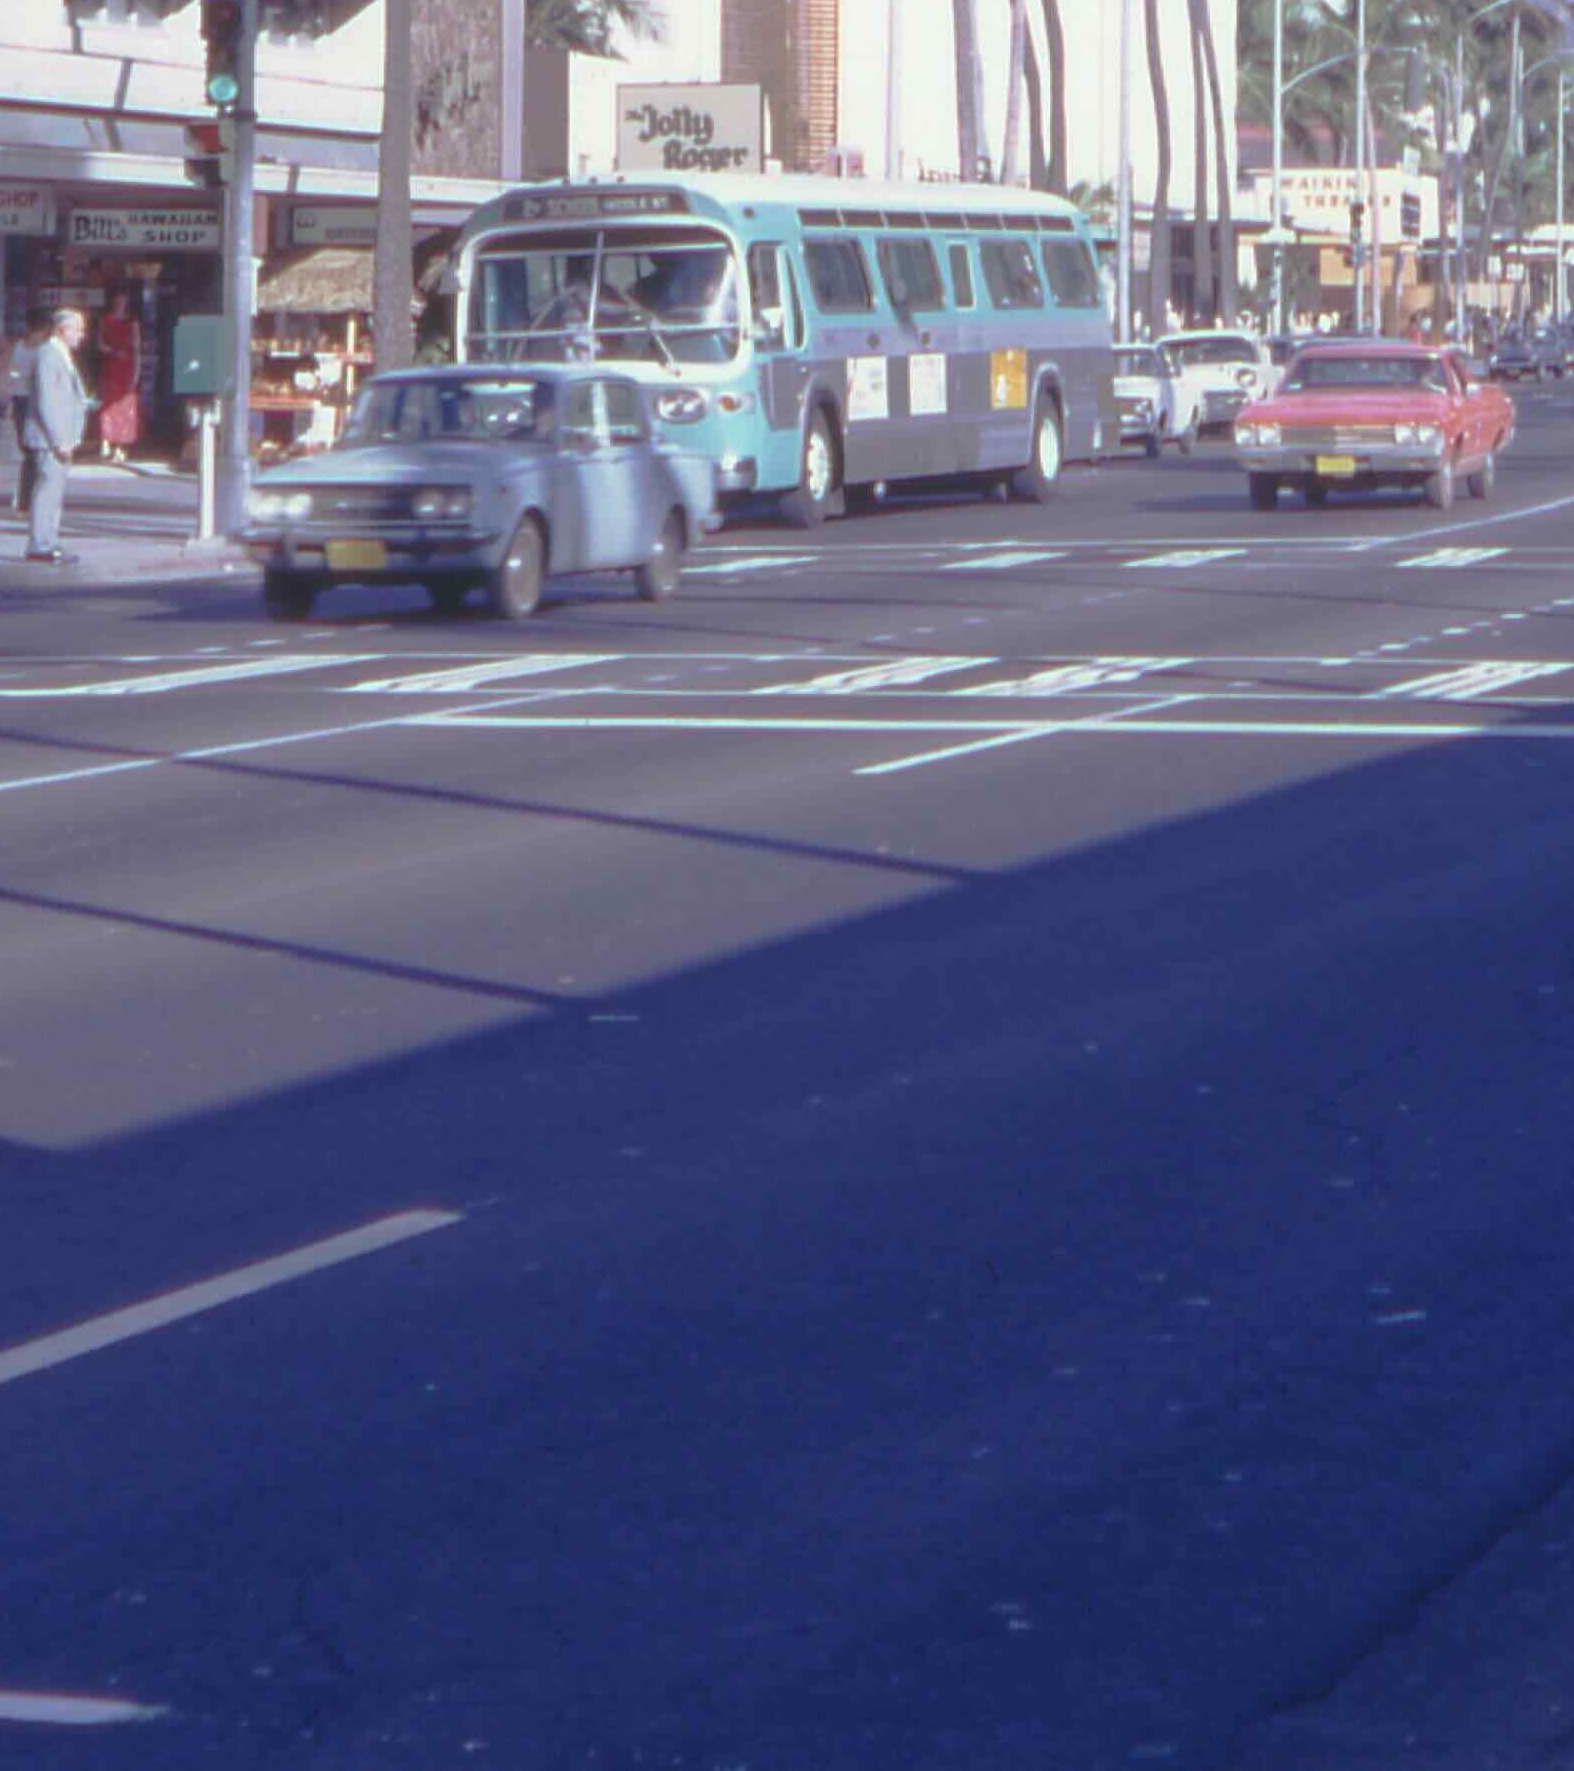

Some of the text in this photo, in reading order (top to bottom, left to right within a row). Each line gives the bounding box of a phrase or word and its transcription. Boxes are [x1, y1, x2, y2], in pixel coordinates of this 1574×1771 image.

[638, 104, 715, 146] Jolly
[662, 140, 749, 172] Roger
[1303, 193, 1391, 208] THEAER
[143, 230, 206, 244] SHOP
